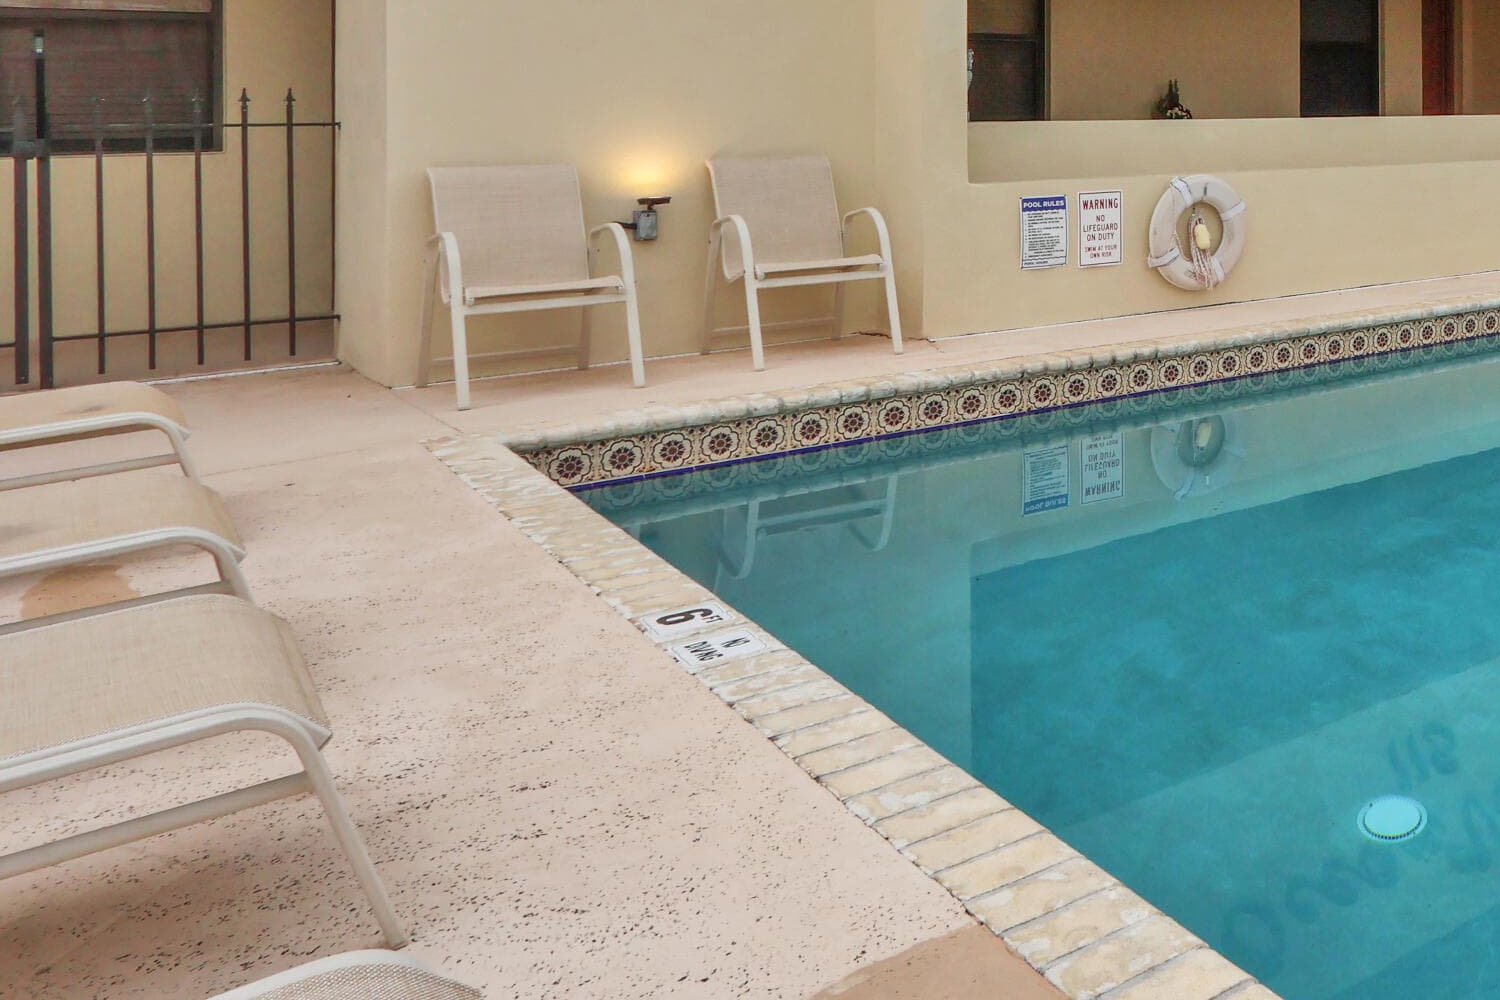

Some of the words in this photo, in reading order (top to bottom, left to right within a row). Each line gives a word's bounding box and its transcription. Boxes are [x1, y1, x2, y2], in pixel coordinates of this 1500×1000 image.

[1082, 198, 1119, 210] WARNING
[1096, 214, 1105, 222] NO
[1083, 222, 1118, 232] LIFEGUARD
[1099, 232, 1115, 241] DUTY
[656, 608, 713, 625] 6
